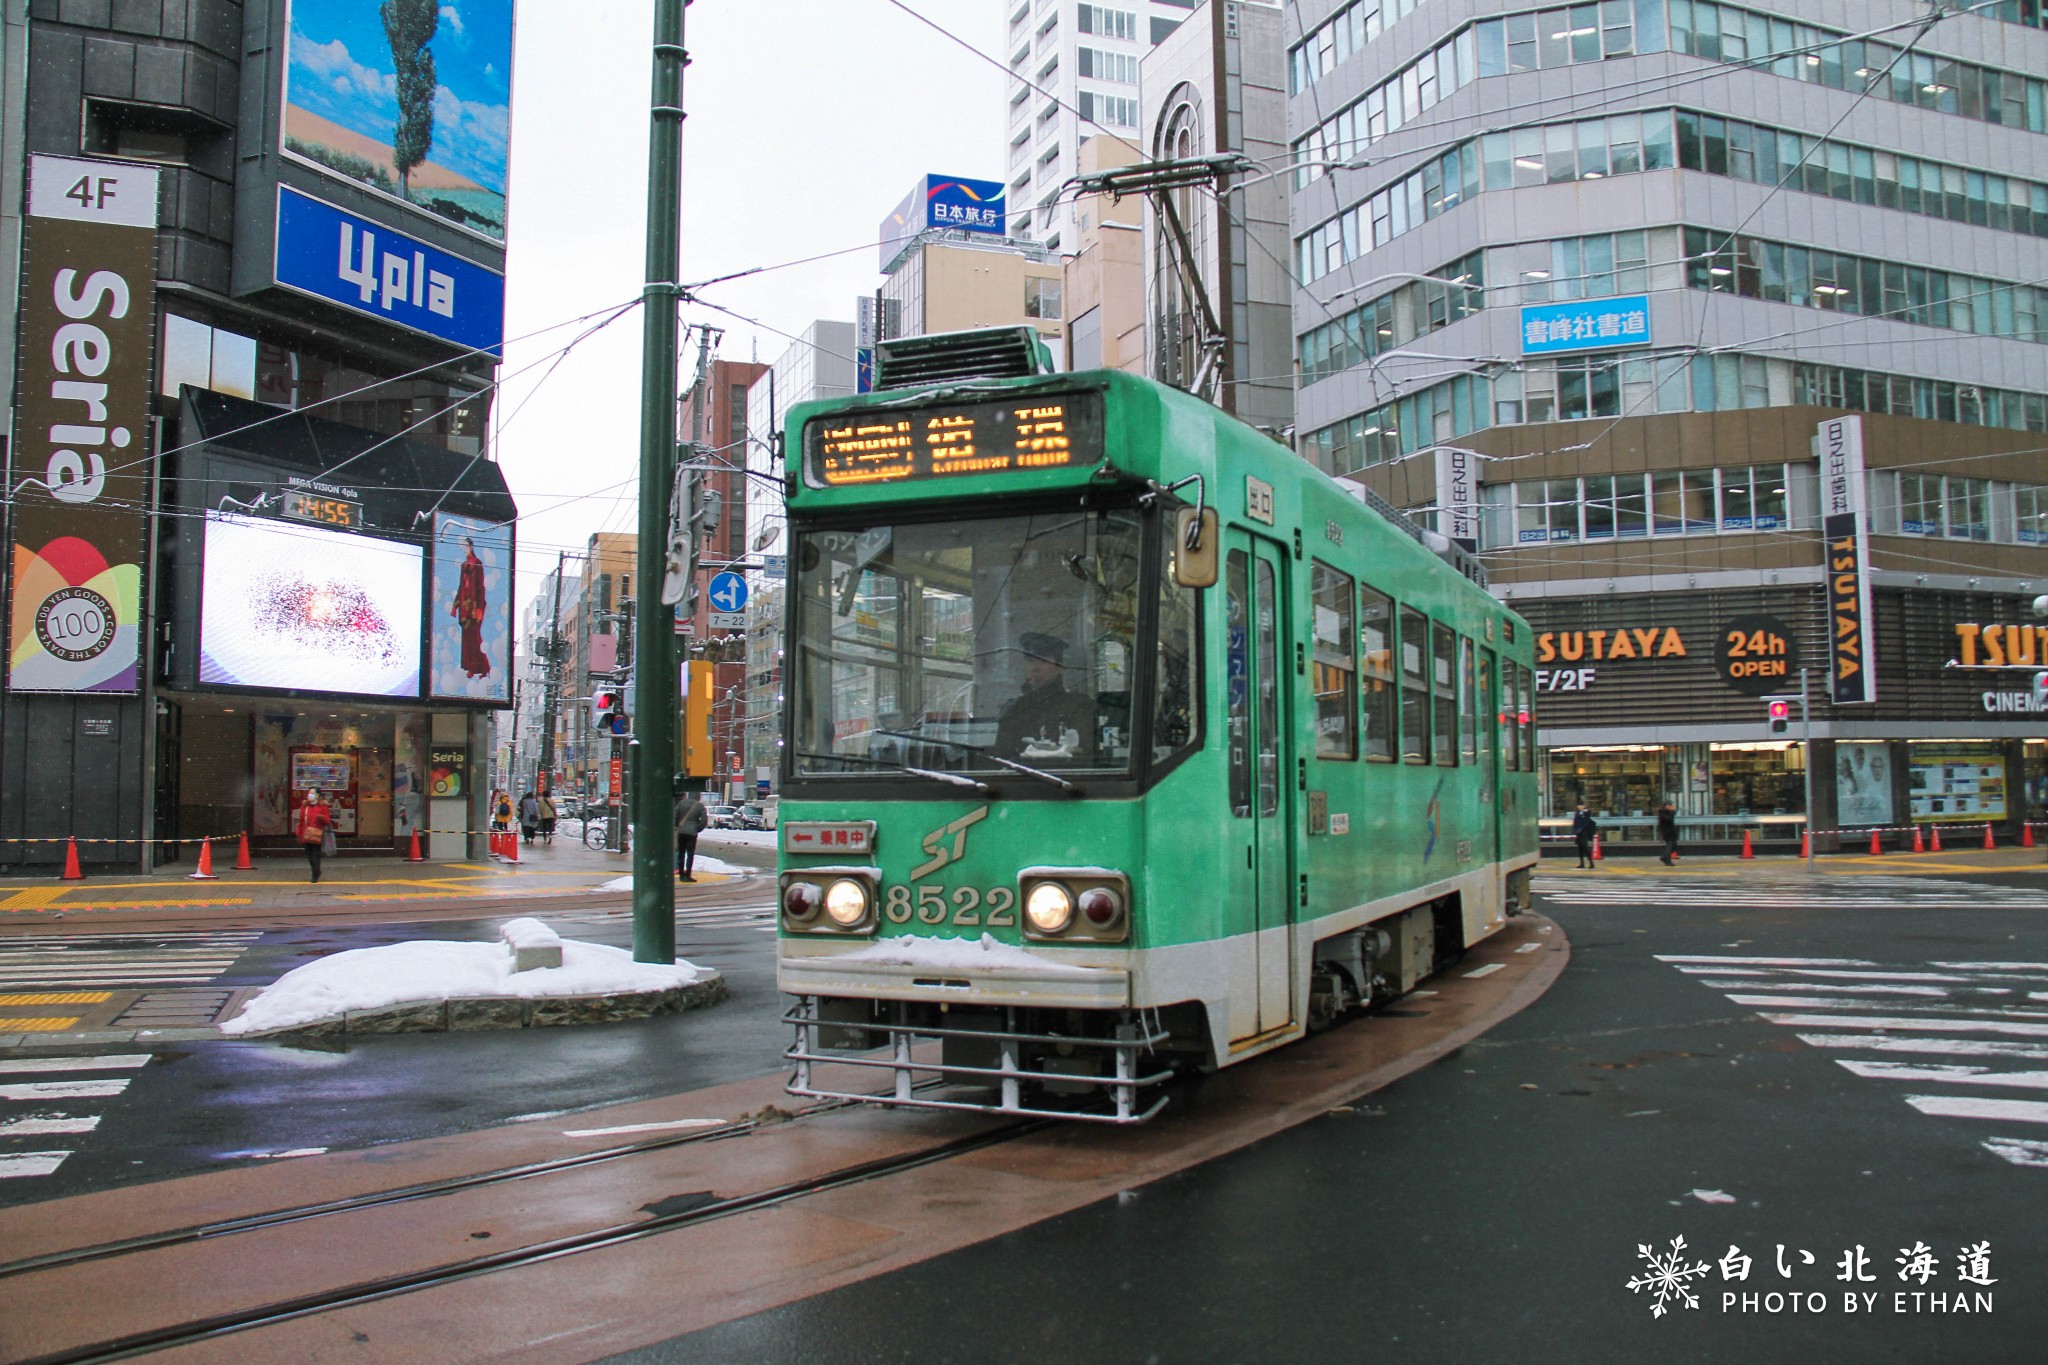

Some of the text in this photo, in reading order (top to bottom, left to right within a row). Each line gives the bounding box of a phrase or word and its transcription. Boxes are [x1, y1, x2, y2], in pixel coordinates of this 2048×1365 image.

[65, 175, 118, 210] 4F
[935, 203, 996, 223] 日本旅行
[339, 221, 455, 319] 4pla
[1525, 310, 1646, 345] 書峰社書道
[47, 268, 131, 503] Seria
[1828, 422, 1848, 513] 日之出歯科
[288, 476, 358, 498] MEGA VISION 4pla
[1249, 486, 1270, 514] 出口
[299, 496, 350, 525] 14:55
[823, 533, 888, 552] ワンマン
[50, 590, 71, 605] YEN
[74, 589, 110, 613] GOODS
[1833, 536, 1860, 680] TSUTAYA
[51, 610, 101, 640] 100
[40, 621, 114, 659] COLOR THE DAYS
[1727, 629, 1786, 657] 24h
[1729, 660, 1786, 678] OPEN
[1982, 691, 2048, 712] CINEM
[432, 752, 464, 763] Seria
[820, 829, 864, 846] 乗降中
[886, 885, 1014, 926] 8522
